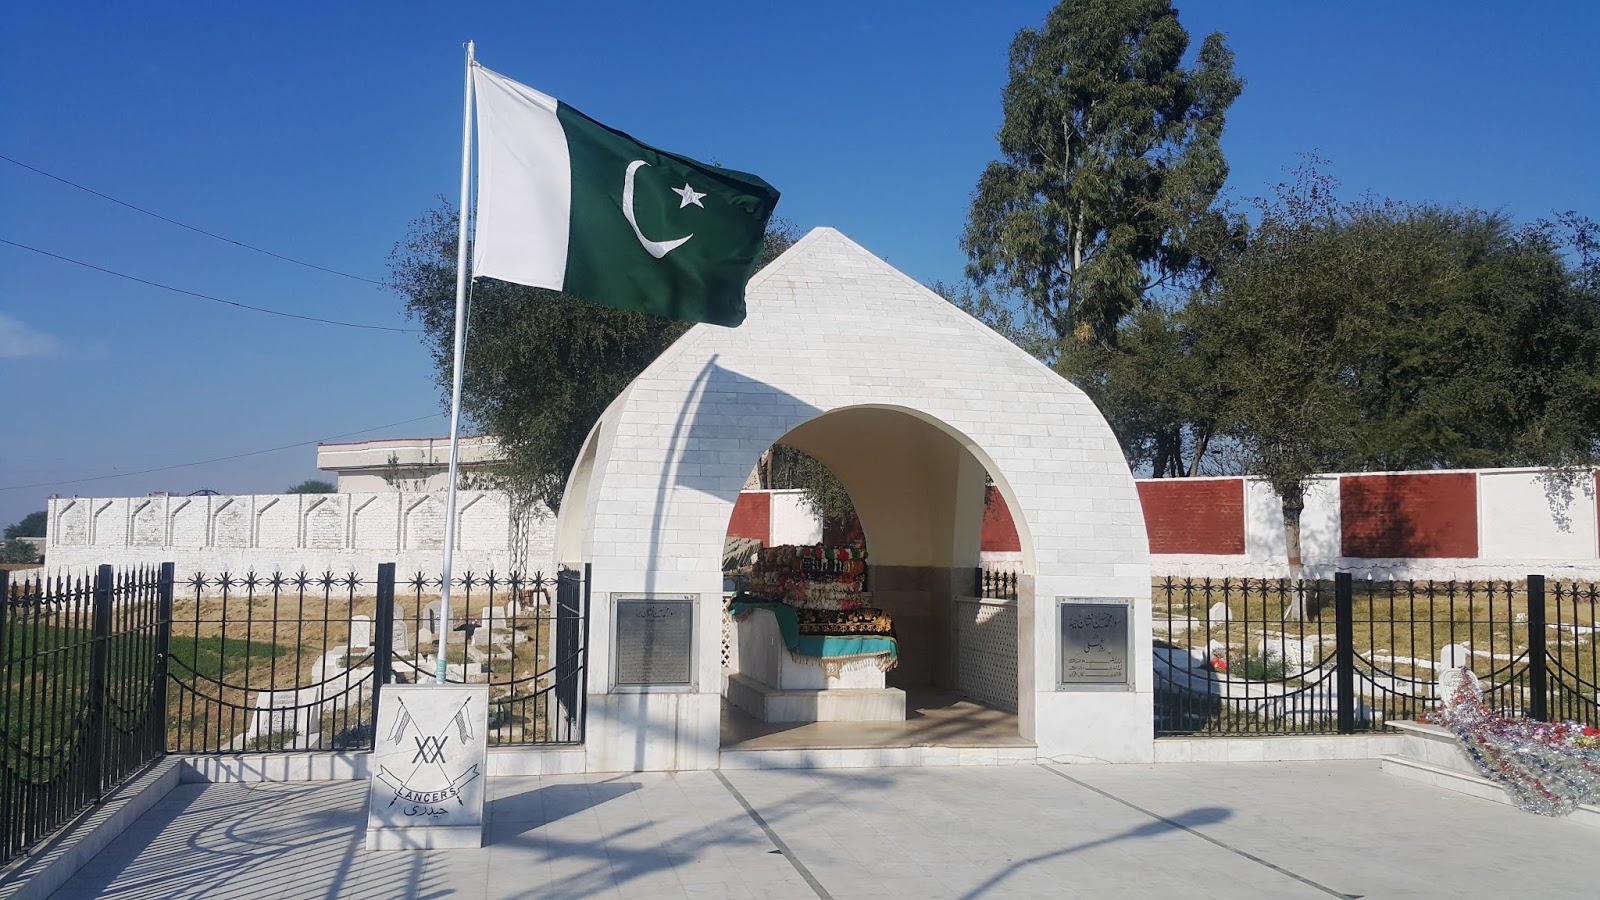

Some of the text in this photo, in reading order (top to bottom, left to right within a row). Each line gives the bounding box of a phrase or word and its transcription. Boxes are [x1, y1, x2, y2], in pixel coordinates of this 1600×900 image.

[412, 736, 448, 764] XX
[397, 787, 457, 802] LANCERS
[403, 805, 449, 817] حیدری
